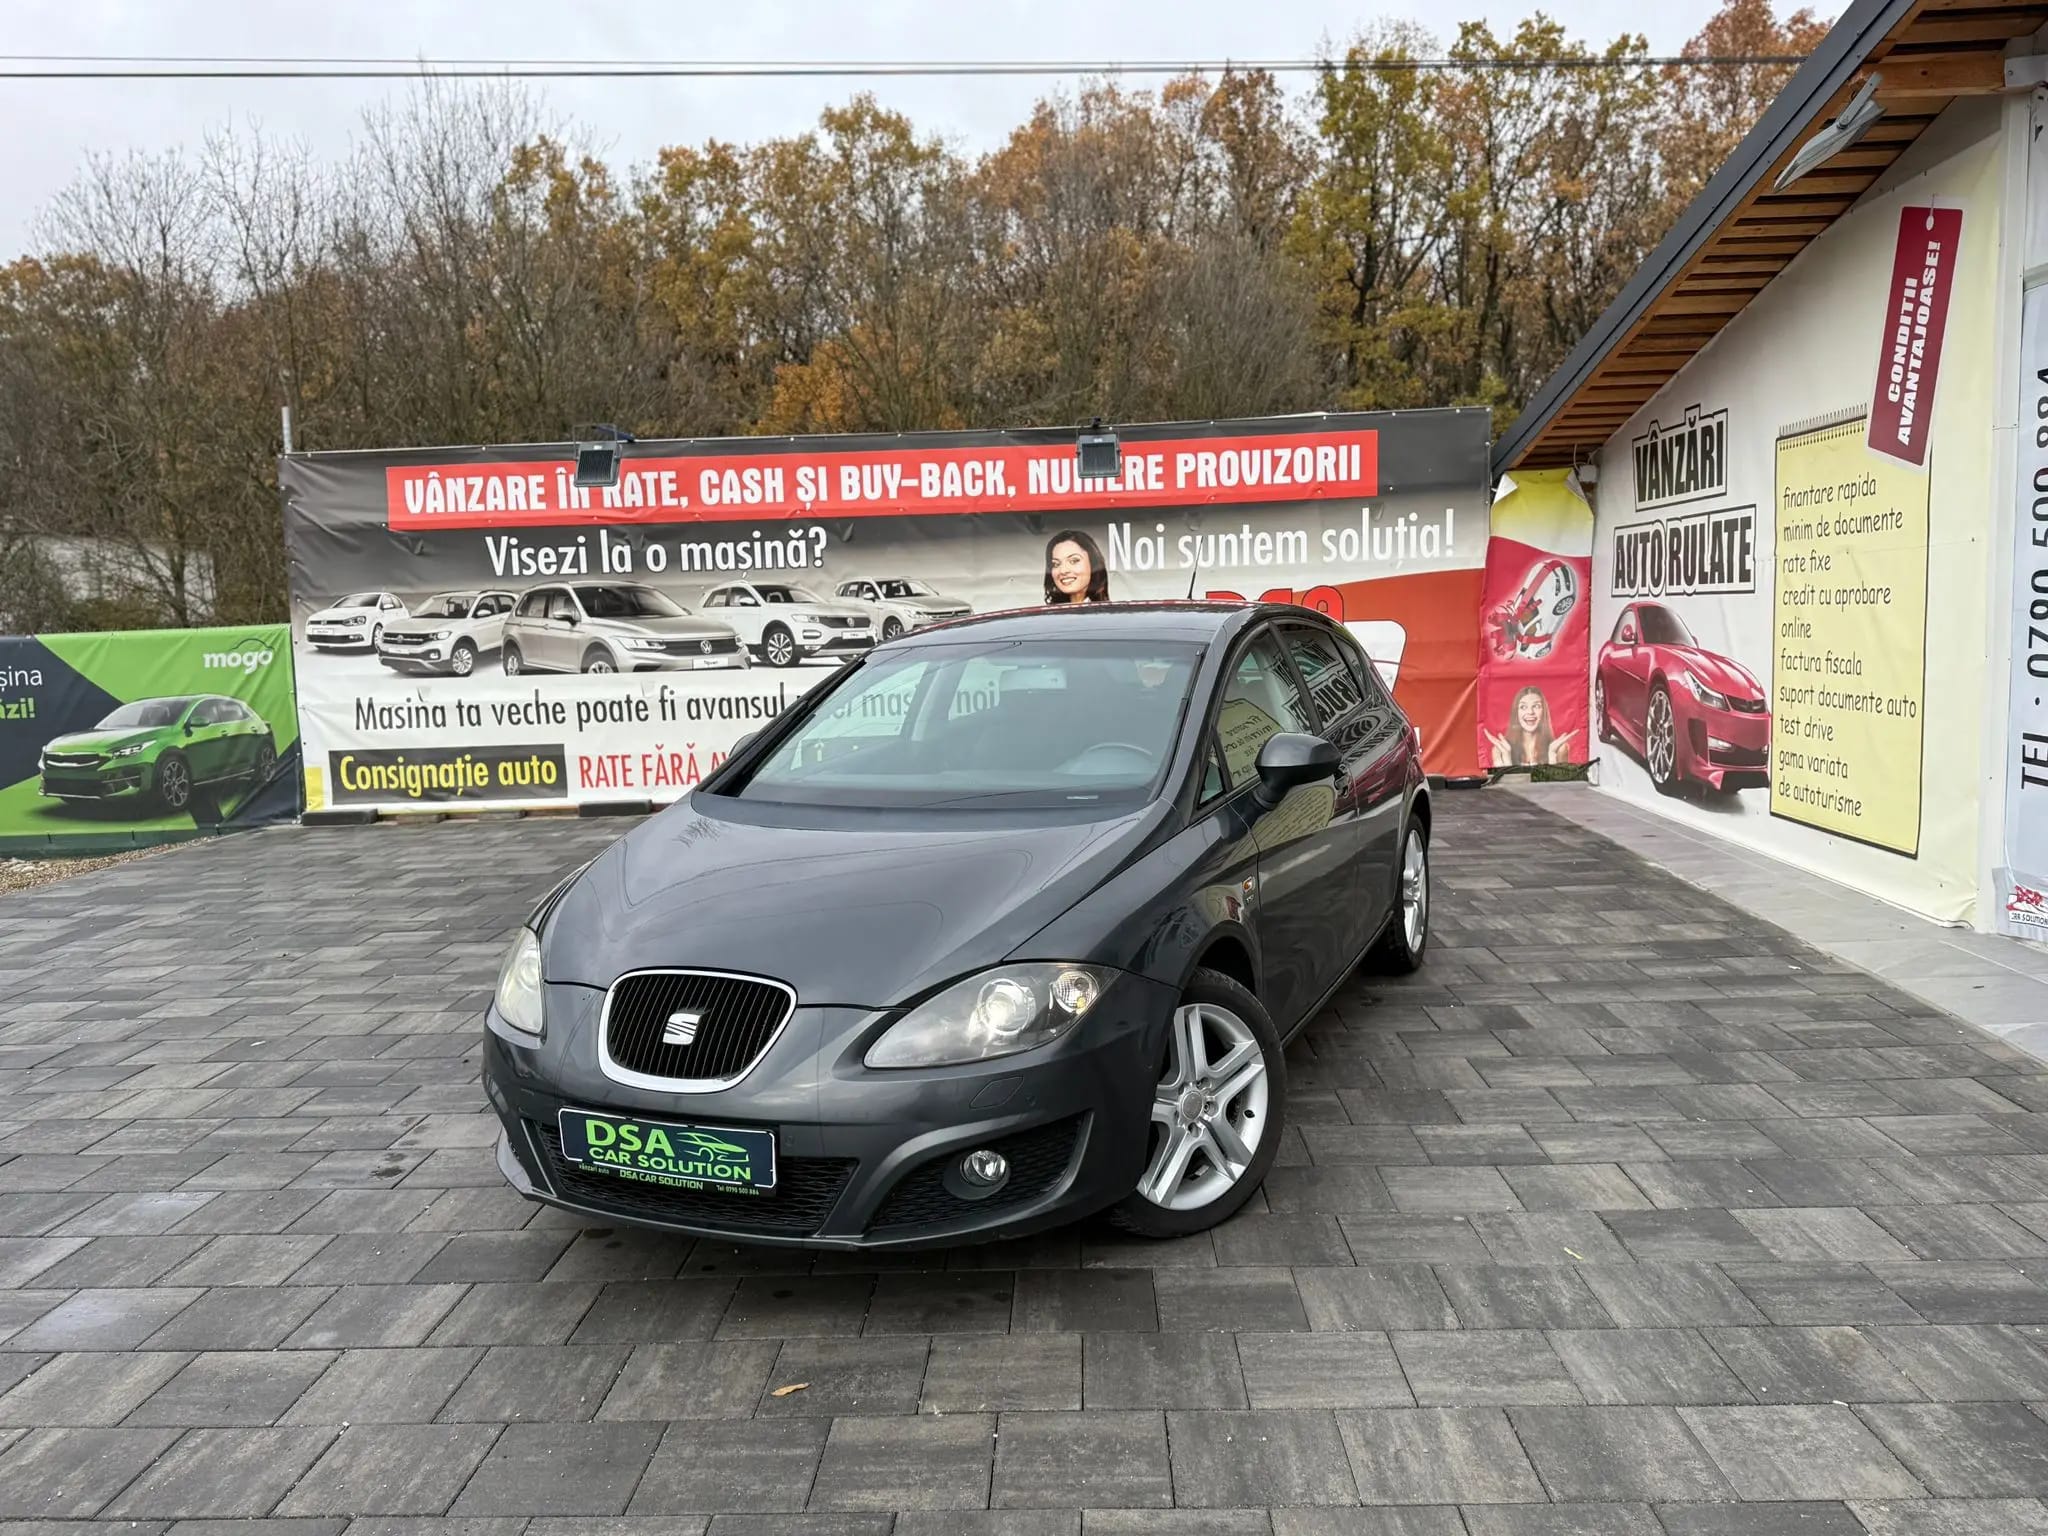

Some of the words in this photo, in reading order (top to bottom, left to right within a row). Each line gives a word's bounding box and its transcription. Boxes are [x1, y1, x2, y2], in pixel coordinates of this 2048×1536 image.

[1888, 277, 1918, 403] CONDITII
[1897, 240, 1941, 446] AVANTAJOASE!
[1635, 415, 1724, 503] VÂNZĂRI
[404, 470, 547, 514] VÂNZARE
[604, 470, 689, 510] RATE,
[700, 467, 784, 507] CASH
[796, 466, 828, 511] ȘI
[840, 460, 1016, 502] BUY-BACK,
[1176, 444, 1361, 489] PROVIZORII
[1783, 484, 1834, 510] finantare
[1837, 471, 1877, 506] rapida
[1107, 521, 1166, 572] Noi
[1178, 522, 1308, 570] suntem
[1321, 507, 1455, 569] soluția!
[1783, 518, 1813, 542] minim
[1816, 515, 1831, 538] de
[1834, 508, 1903, 536] documente
[485, 535, 589, 577] Visezi
[600, 528, 633, 574] la
[646, 543, 669, 573] o
[680, 526, 828, 578] mașină?
[1783, 556, 1806, 573] rate
[1810, 549, 1831, 573] fixe
[1783, 584, 1815, 606] credit
[1819, 589, 1832, 606] cu
[1835, 580, 1891, 612] aprobare
[1781, 616, 1812, 639] online
[203, 650, 274, 674] mogo
[1781, 648, 1821, 673] factura
[1825, 650, 1862, 676] fiscala
[456, 698, 482, 727] ta
[493, 688, 566, 727] veche
[577, 693, 650, 733] poate
[658, 684, 677, 722] fi
[686, 682, 785, 721] avansul
[1780, 685, 1814, 709] suport
[1818, 684, 1883, 714] documente
[1887, 694, 1917, 718] auto
[1780, 713, 1801, 736] test
[1804, 716, 1834, 741] drive
[340, 755, 489, 797] Consignație
[498, 755, 557, 786] auto
[580, 754, 634, 788] RATE
[642, 742, 700, 786] FĂRĂ
[1779, 749, 1804, 771] gama
[1807, 753, 1848, 779] variata
[1779, 776, 1791, 797] de
[1793, 784, 1862, 817] autoturisme
[585, 1119, 675, 1157] DSA
[589, 1146, 632, 1164] CAR
[638, 1155, 751, 1180] SOLUTION
[620, 1169, 638, 1180] DSA
[639, 1173, 657, 1184] CAR
[658, 1176, 703, 1190] SOLUTION
